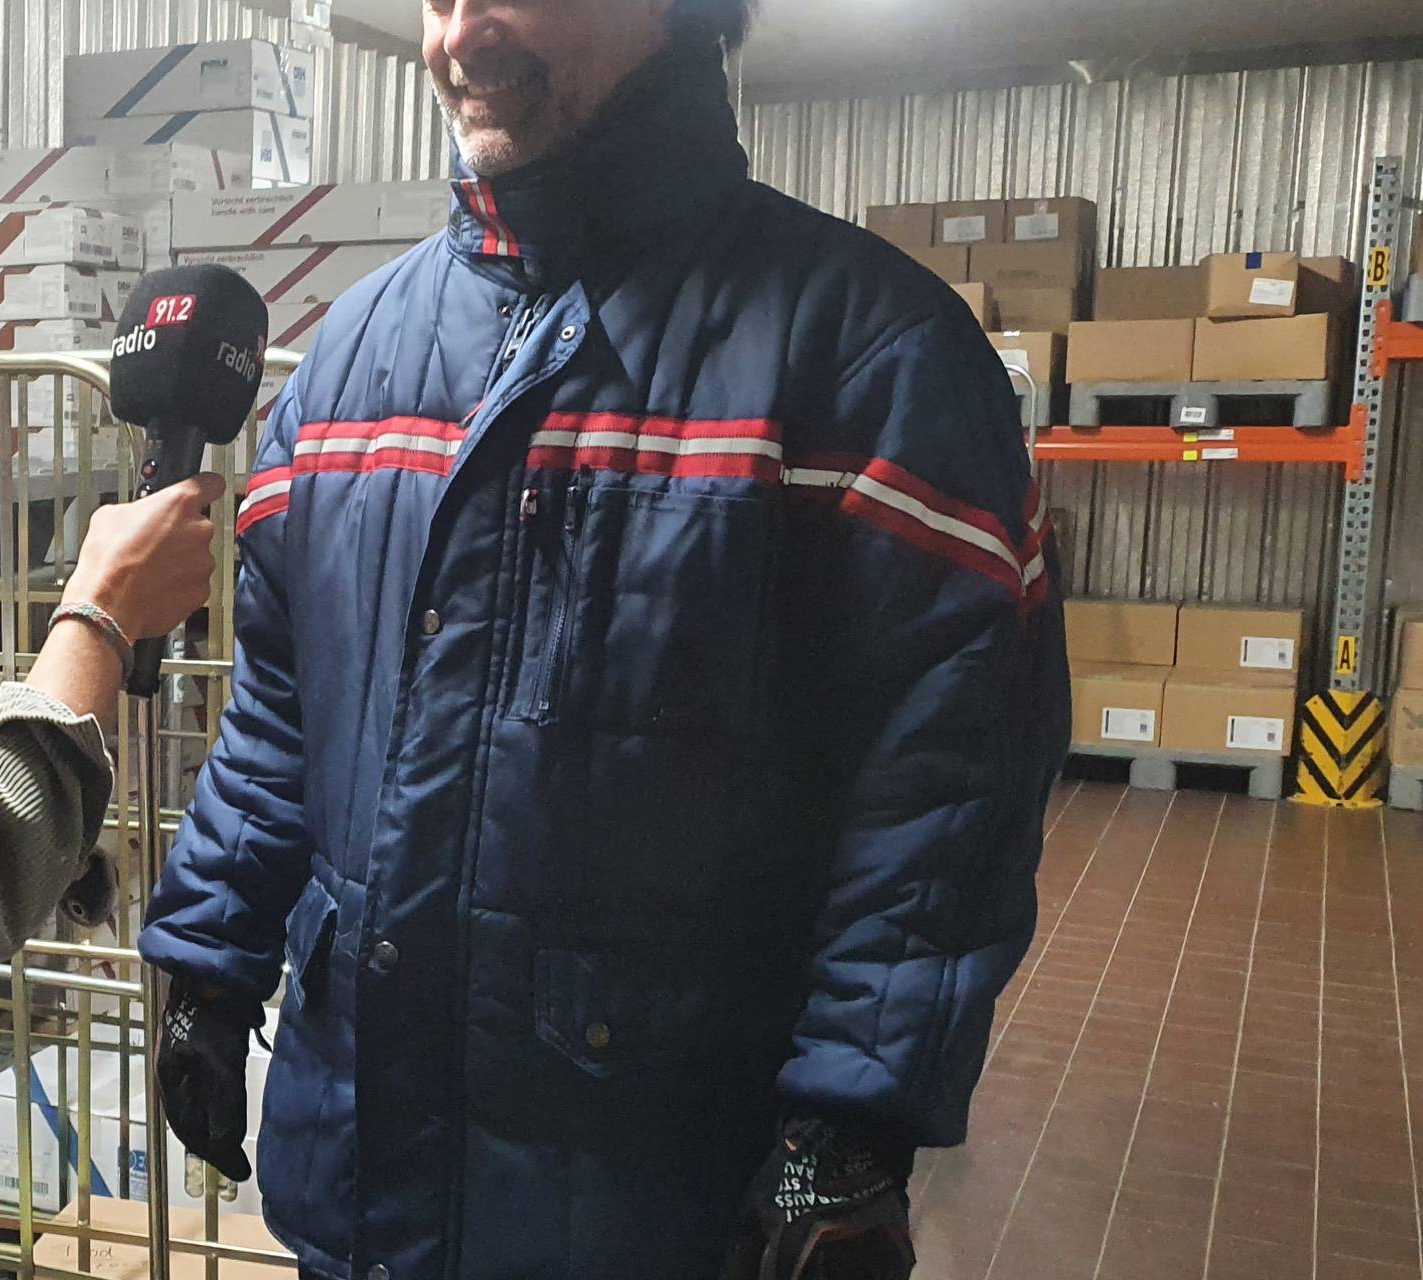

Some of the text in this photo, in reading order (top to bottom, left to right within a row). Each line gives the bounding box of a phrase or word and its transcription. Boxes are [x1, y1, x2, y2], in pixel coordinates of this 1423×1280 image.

[1373, 250, 1386, 282] B
[154, 296, 193, 323] 91.2
[112, 323, 157, 358] radio
[216, 340, 256, 382] radio
[1339, 640, 1350, 670] A
